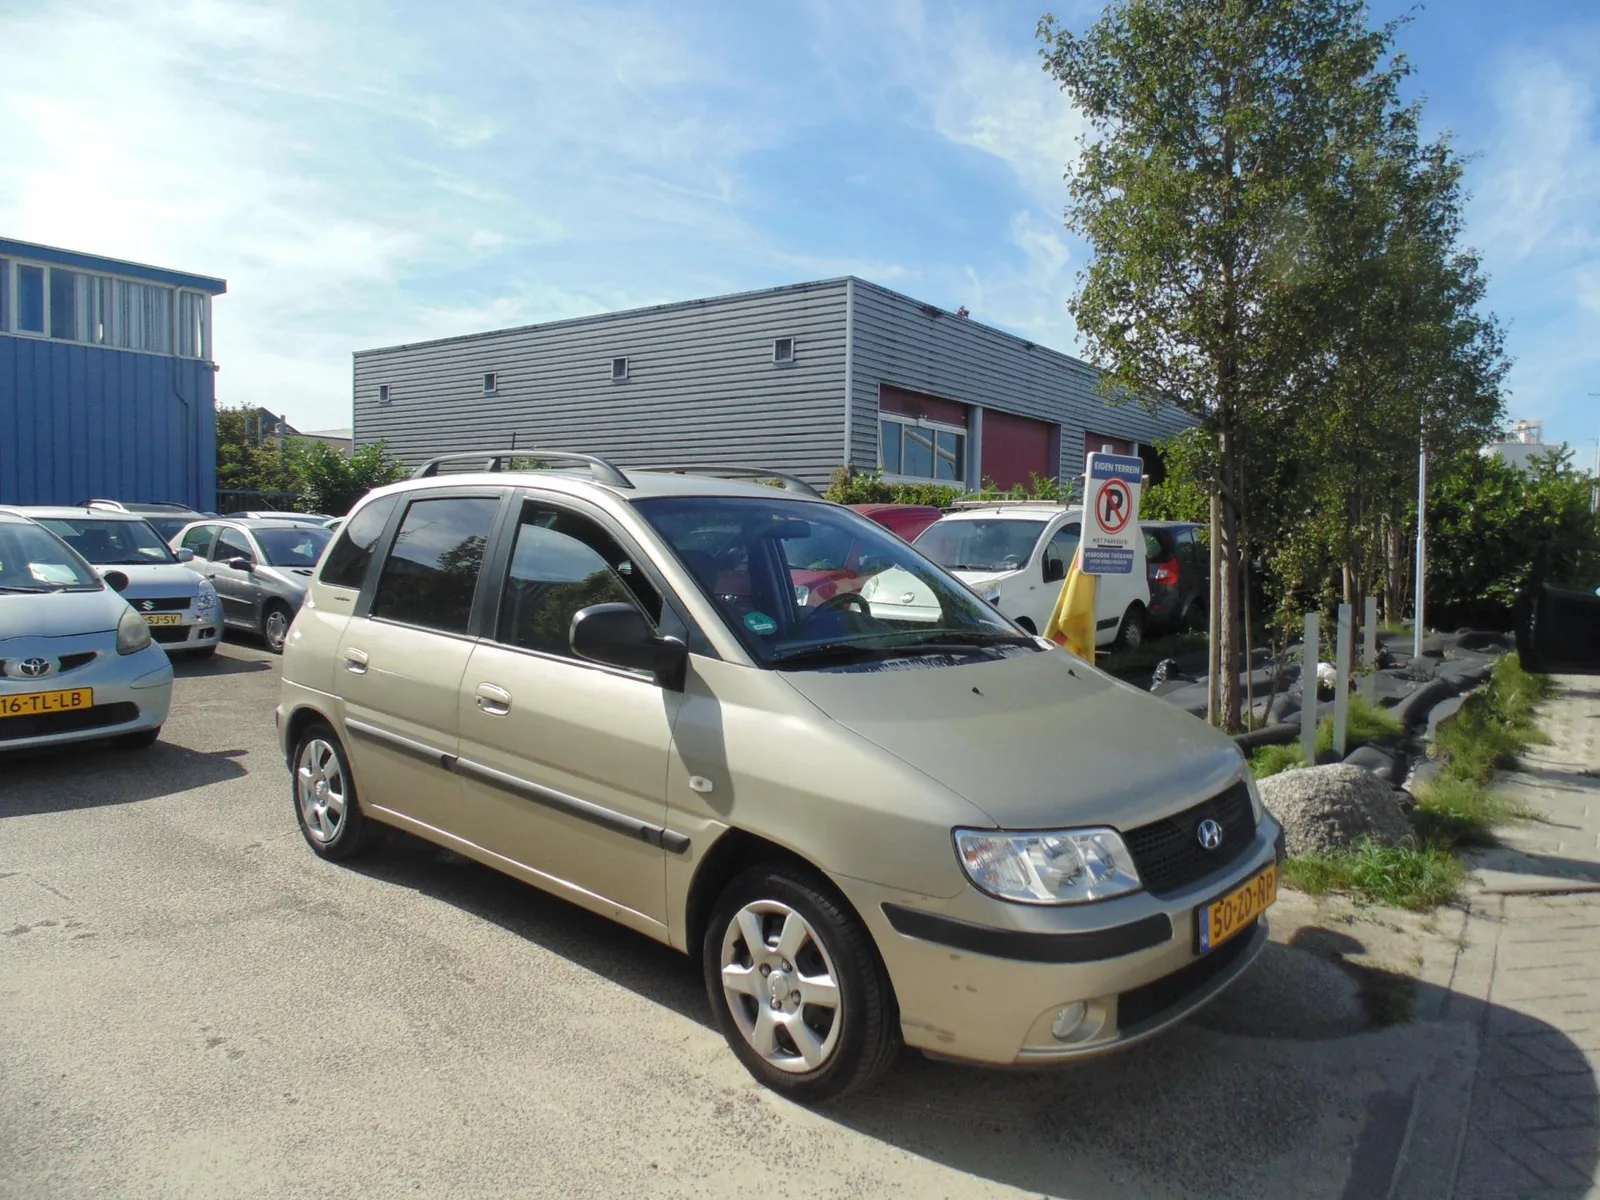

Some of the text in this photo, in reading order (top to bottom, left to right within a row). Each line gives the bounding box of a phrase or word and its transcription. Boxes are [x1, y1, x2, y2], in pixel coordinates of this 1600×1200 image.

[1094, 461, 1140, 475] EIGEN TERREIN
[144, 615, 177, 625] -SJ-SV
[1, 692, 82, 714] 16-TL-LB
